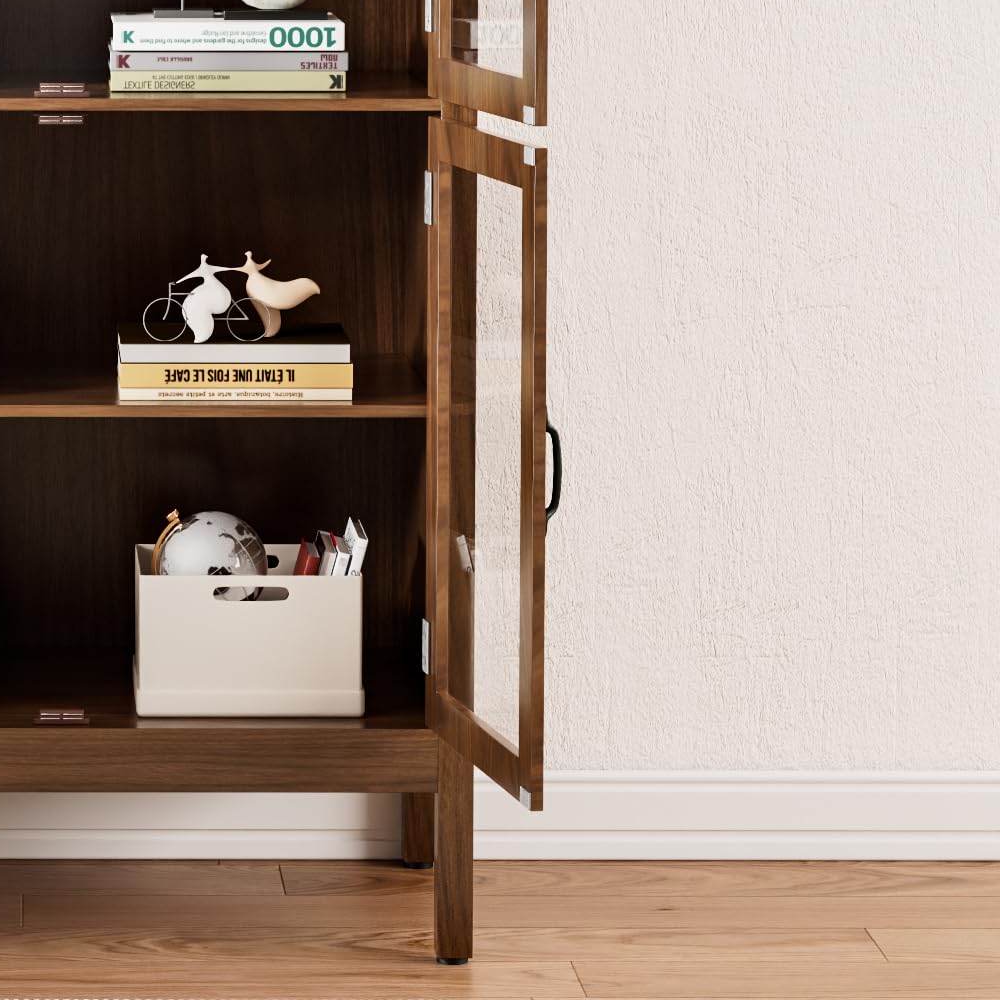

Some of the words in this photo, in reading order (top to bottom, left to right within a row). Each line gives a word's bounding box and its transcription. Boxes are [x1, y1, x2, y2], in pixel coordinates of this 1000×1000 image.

[203, 37, 226, 45] gardens
[269, 26, 337, 48] 1000
[300, 62, 338, 70] TEXTILES
[164, 369, 190, 385] CAFÉ
[193, 369, 204, 382] LE
[207, 369, 230, 382] FOIS
[232, 369, 253, 382] UNE
[255, 369, 283, 385] ÉTAIT
[286, 369, 295, 382] IL
